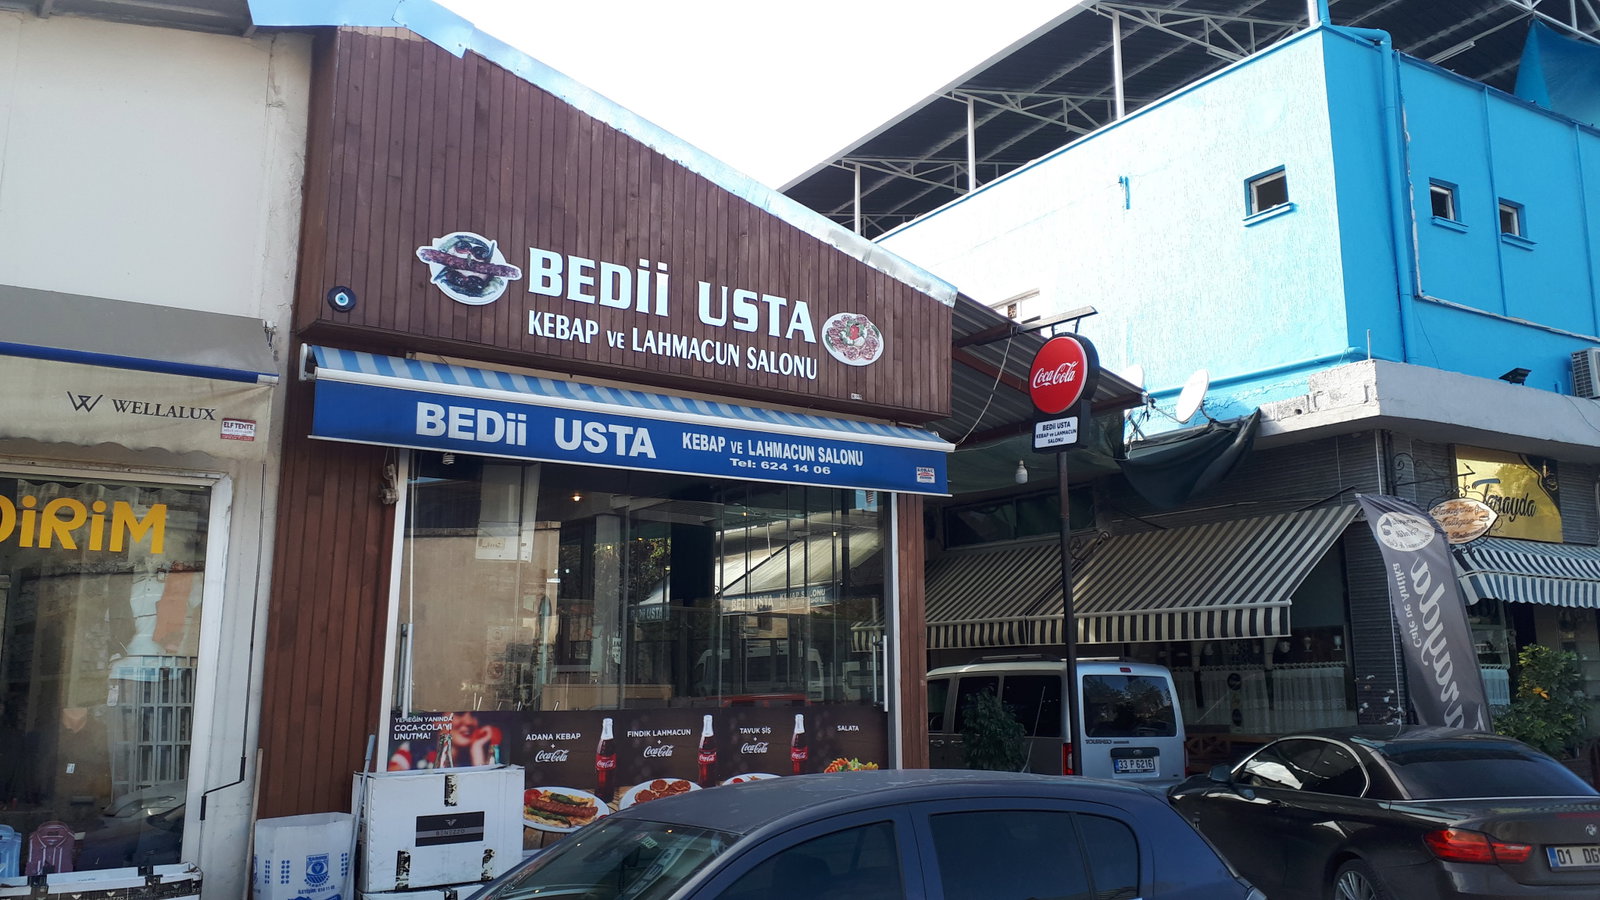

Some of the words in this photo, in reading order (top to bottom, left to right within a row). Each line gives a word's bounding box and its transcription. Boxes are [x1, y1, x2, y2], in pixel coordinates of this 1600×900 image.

[698, 280, 817, 344] USTA
[528, 310, 599, 344] KEBAP
[632, 327, 740, 367] LAHMACUN
[747, 346, 817, 380] SALONU
[111, 398, 216, 421] WELLALUX
[1057, 421, 1071, 430] USTA
[554, 417, 657, 459] USTA
[682, 432, 726, 453] KEBAP
[748, 439, 815, 462] LAHMACUN
[818, 446, 864, 467] SALONU
[729, 457, 756, 469] Tel:
[760, 461, 788, 472] 624
[793, 464, 809, 473] 14
[813, 465, 831, 475] 06
[394, 732, 431, 740] UNUTMA!
[526, 733, 553, 741] ADANA
[555, 732, 581, 740] KEBAP
[627, 730, 651, 738] FINDIK
[652, 728, 692, 737] LAHMACUN
[739, 727, 760, 735] TAVUK
[1118, 760, 1128, 769] 33
[1130, 760, 1135, 768] P
[1136, 759, 1153, 769] 6216
[1556, 848, 1573, 865] 01
[1582, 847, 1600, 864] DG
